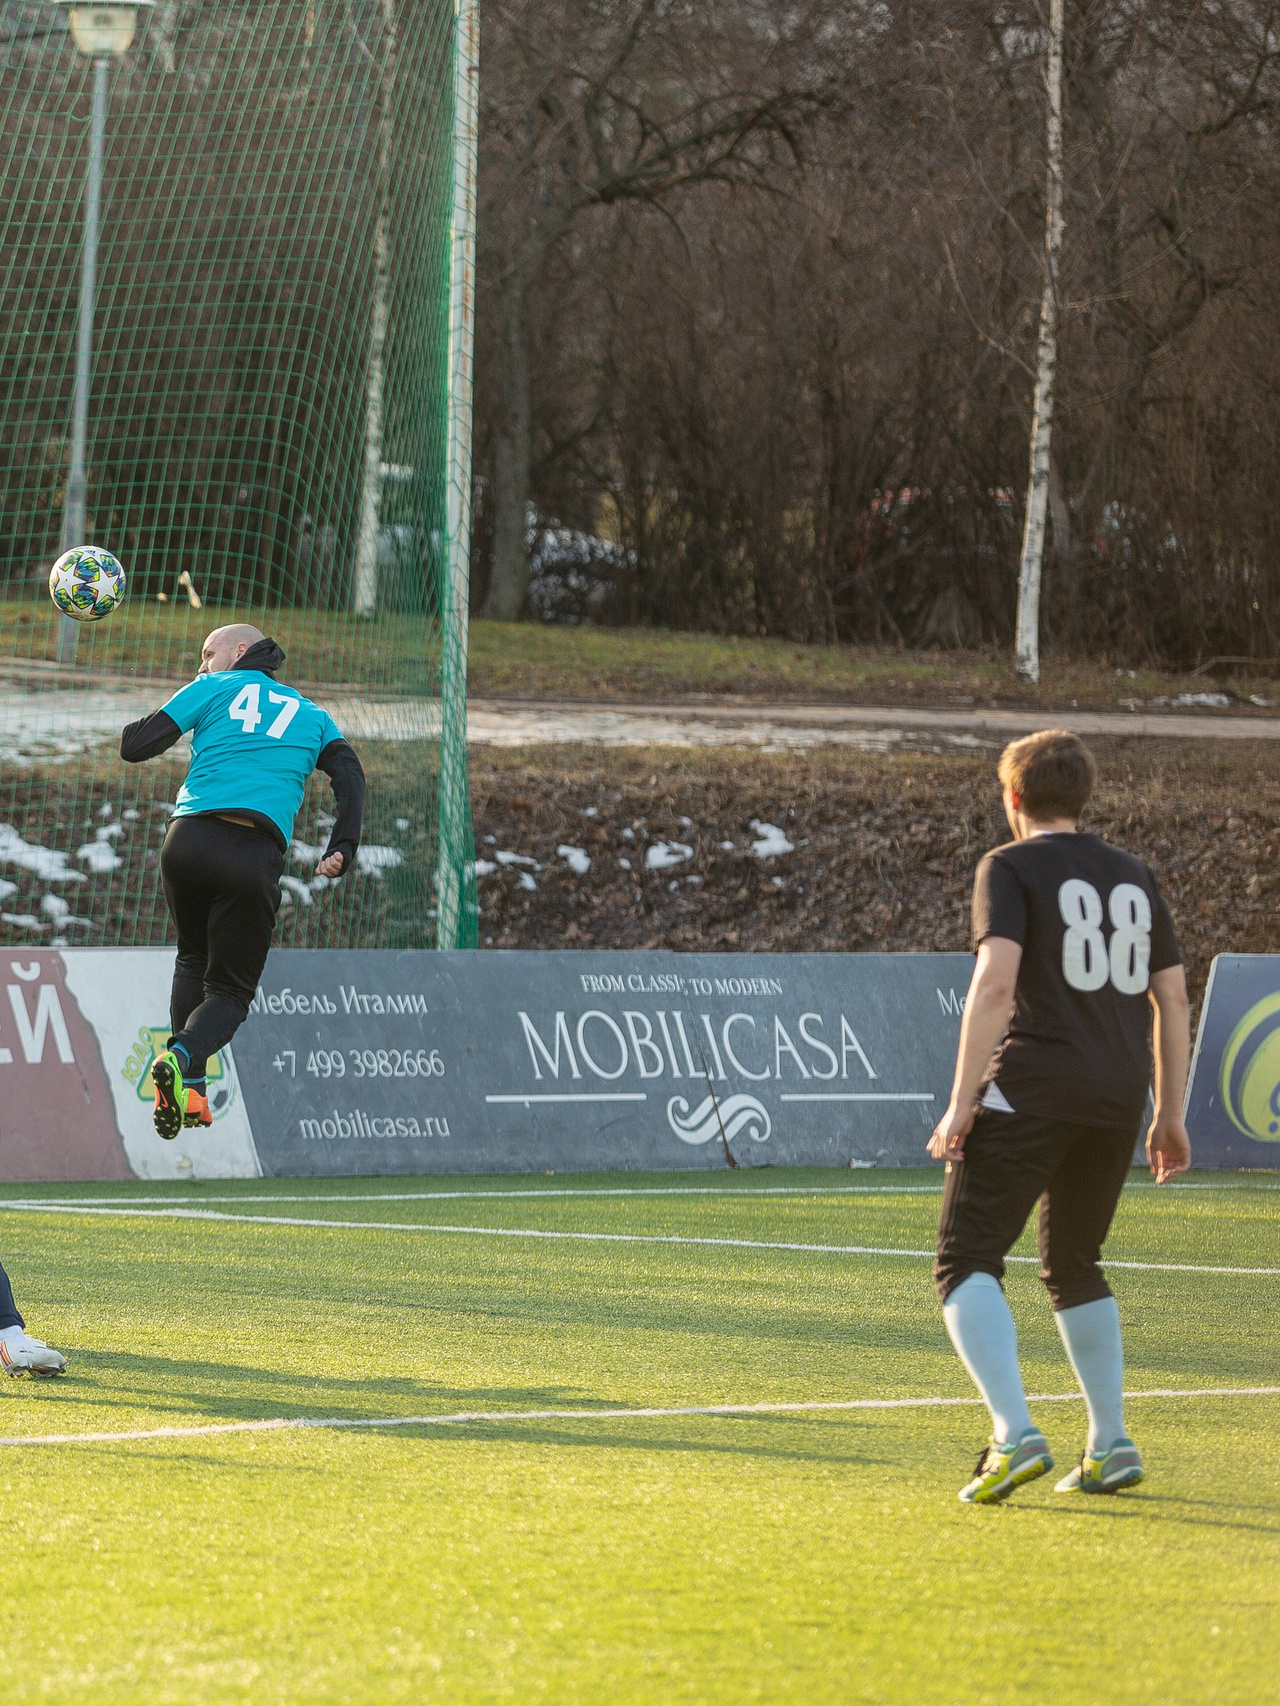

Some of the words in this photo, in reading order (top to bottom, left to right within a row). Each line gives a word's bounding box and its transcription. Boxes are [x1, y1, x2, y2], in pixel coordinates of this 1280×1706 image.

[228, 683, 300, 739] 47
[1058, 879, 1152, 995] 88
[248, 985, 337, 1015] Мебель
[339, 985, 428, 1014] Италии
[580, 974, 626, 993] FROM
[689, 978, 713, 997] TO
[714, 978, 783, 997] MODERN
[518, 1010, 878, 1081] MOBILICASA
[273, 1051, 296, 1078] +7
[306, 1050, 345, 1078] 499
[349, 1049, 445, 1078] 3982666
[299, 1109, 451, 1139] mobilicasa.ru
